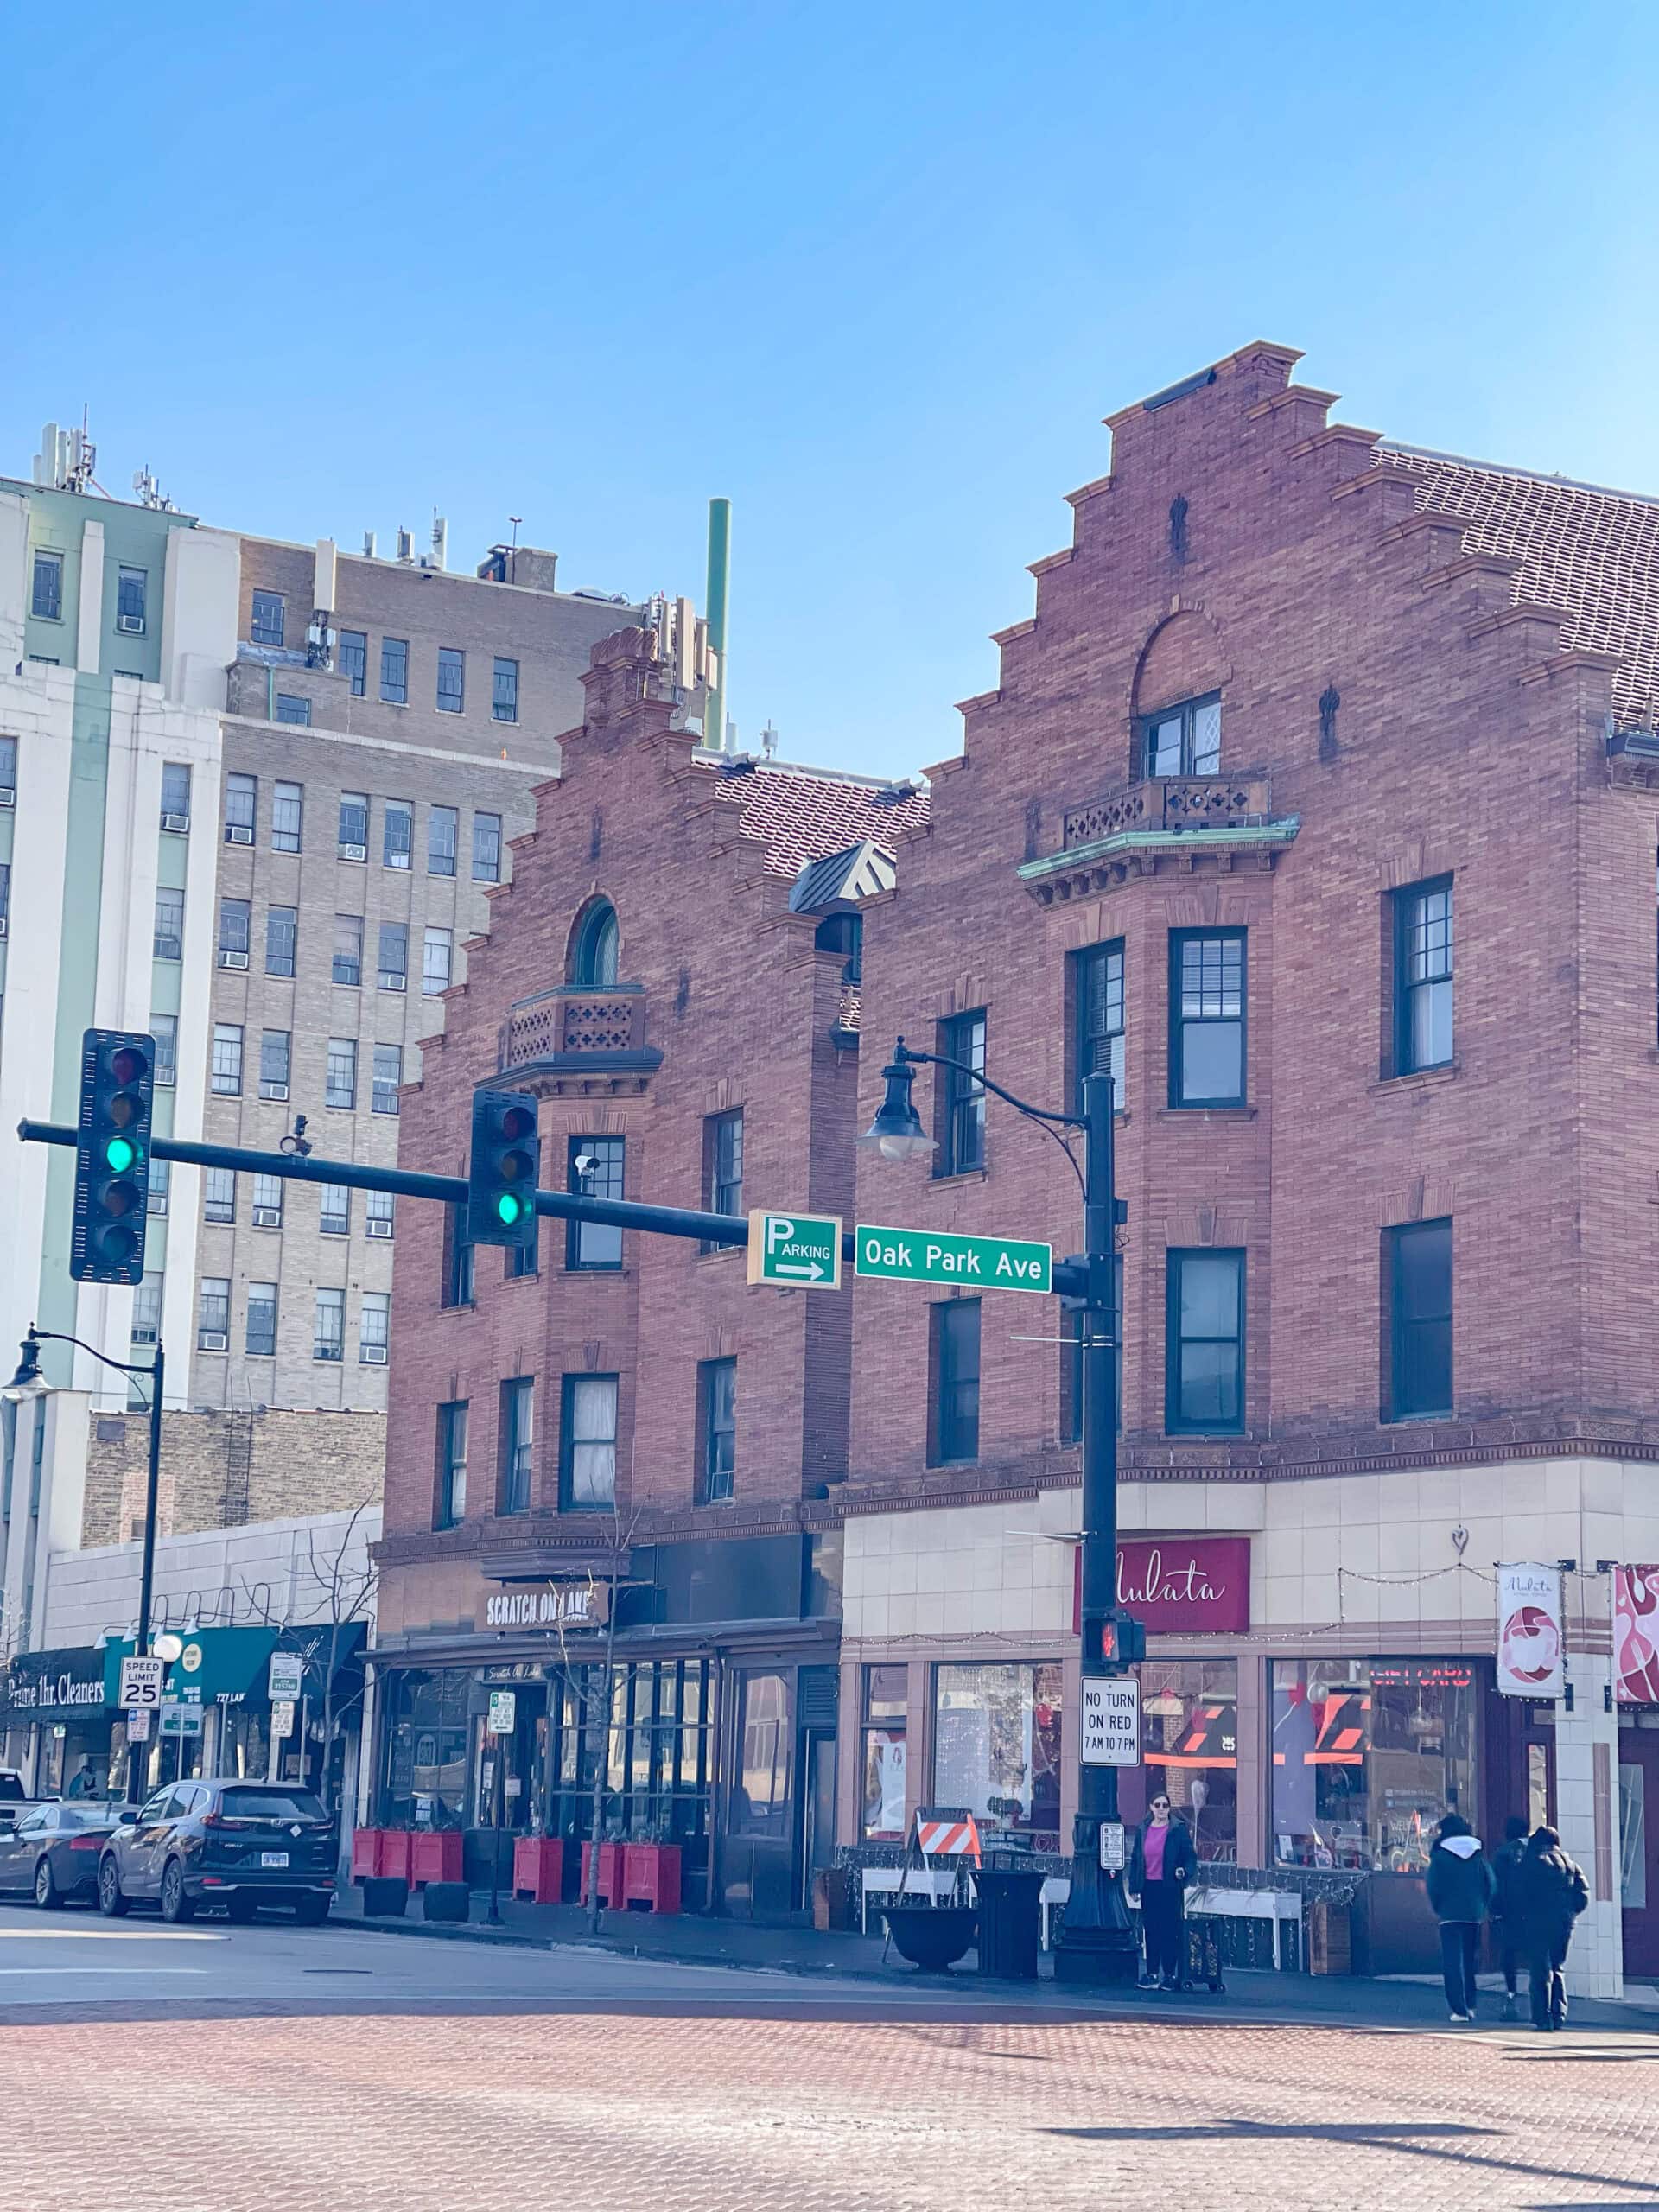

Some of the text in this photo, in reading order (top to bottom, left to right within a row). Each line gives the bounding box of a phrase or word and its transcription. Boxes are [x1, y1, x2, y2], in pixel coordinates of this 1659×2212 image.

[768, 1217, 830, 1260] PARKING
[865, 1238, 1042, 1280] Oak Park Ave
[1116, 1549, 1225, 1604] ulata
[486, 1593, 537, 1625] SCRATCH
[539, 1592, 557, 1621] ON
[125, 1662, 159, 1672] SPEED
[128, 1673, 156, 1681] LIMIT
[57, 1672, 105, 1706] Cleaners
[124, 1684, 156, 1703] 25
[216, 1693, 229, 1703] 727
[1085, 1692, 1135, 1707] NO TURN
[1089, 1714, 1131, 1730] ON RED
[1085, 1736, 1135, 1751] 7 AM TO 7 PM
